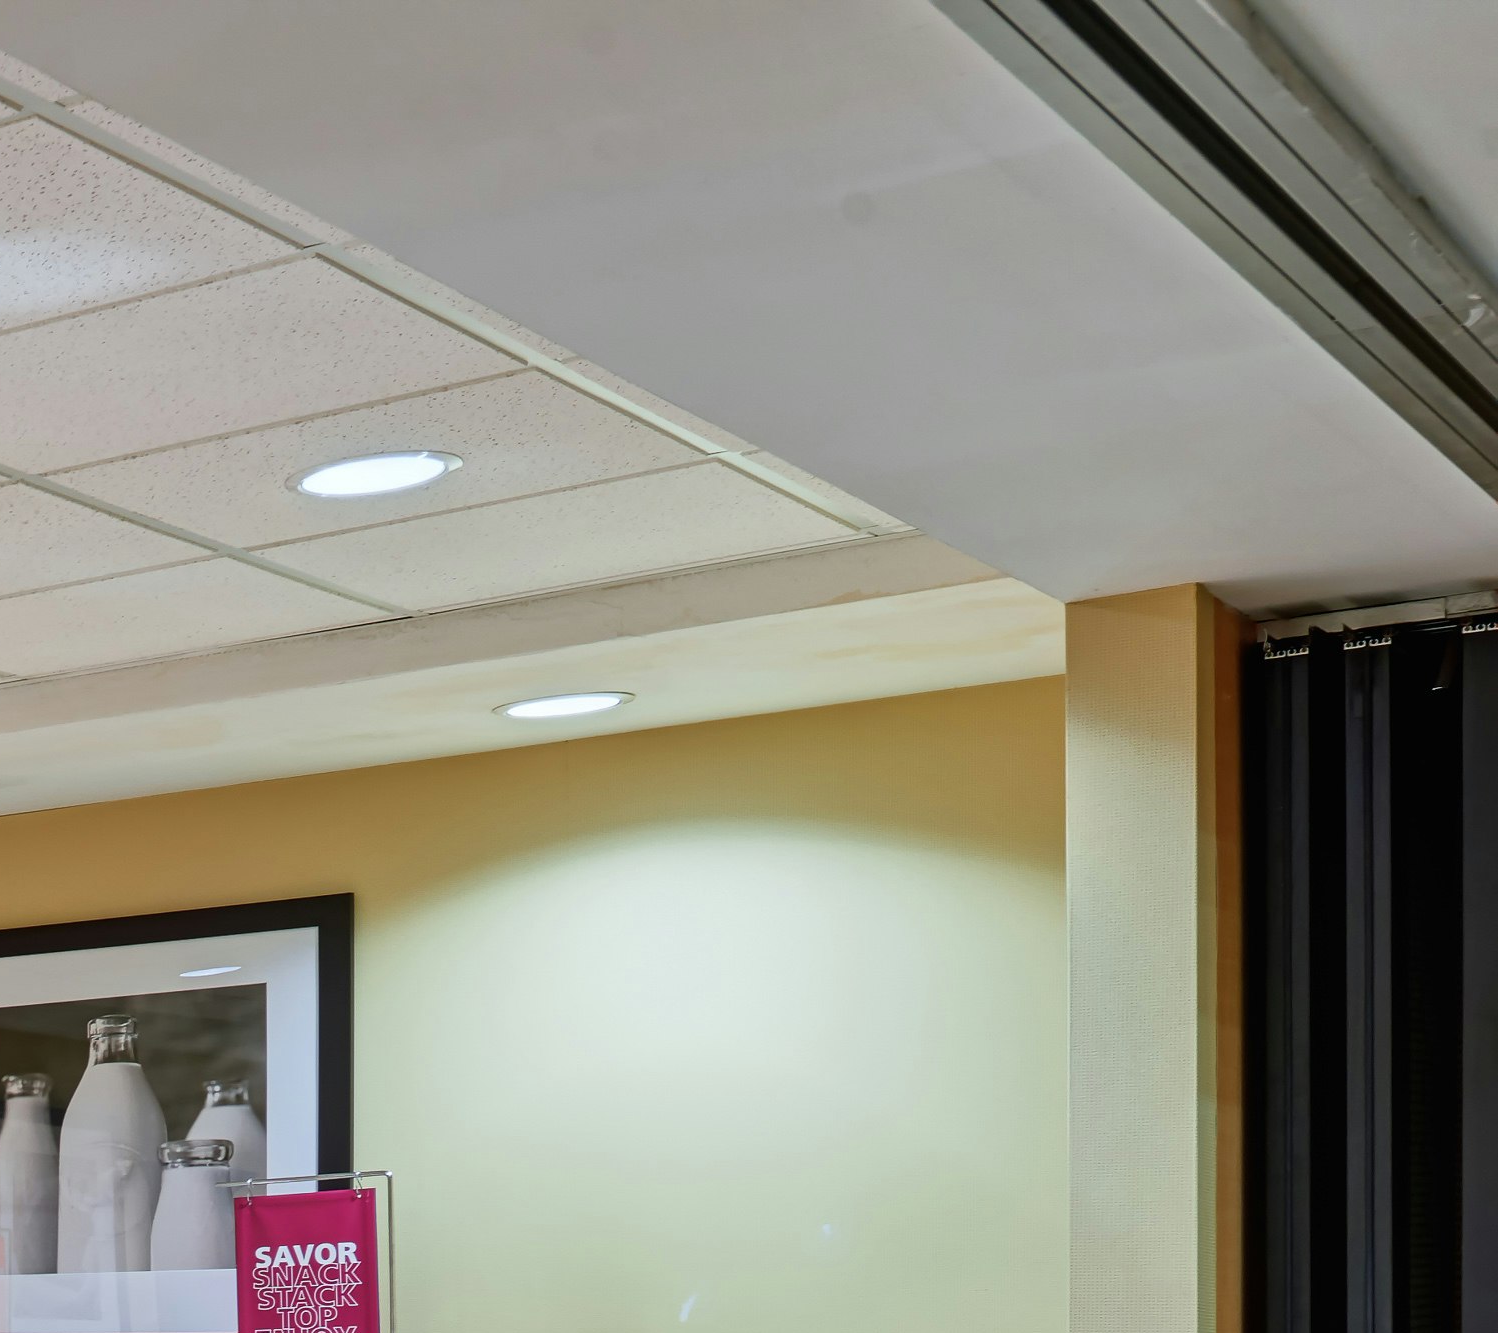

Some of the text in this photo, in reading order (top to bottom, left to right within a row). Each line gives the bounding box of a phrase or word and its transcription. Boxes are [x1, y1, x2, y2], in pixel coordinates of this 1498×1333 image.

[255, 1241, 359, 1269] SAVOR
[252, 1261, 363, 1290] SNACK
[257, 1283, 359, 1311] STACK
[277, 1306, 338, 1331] TOP
